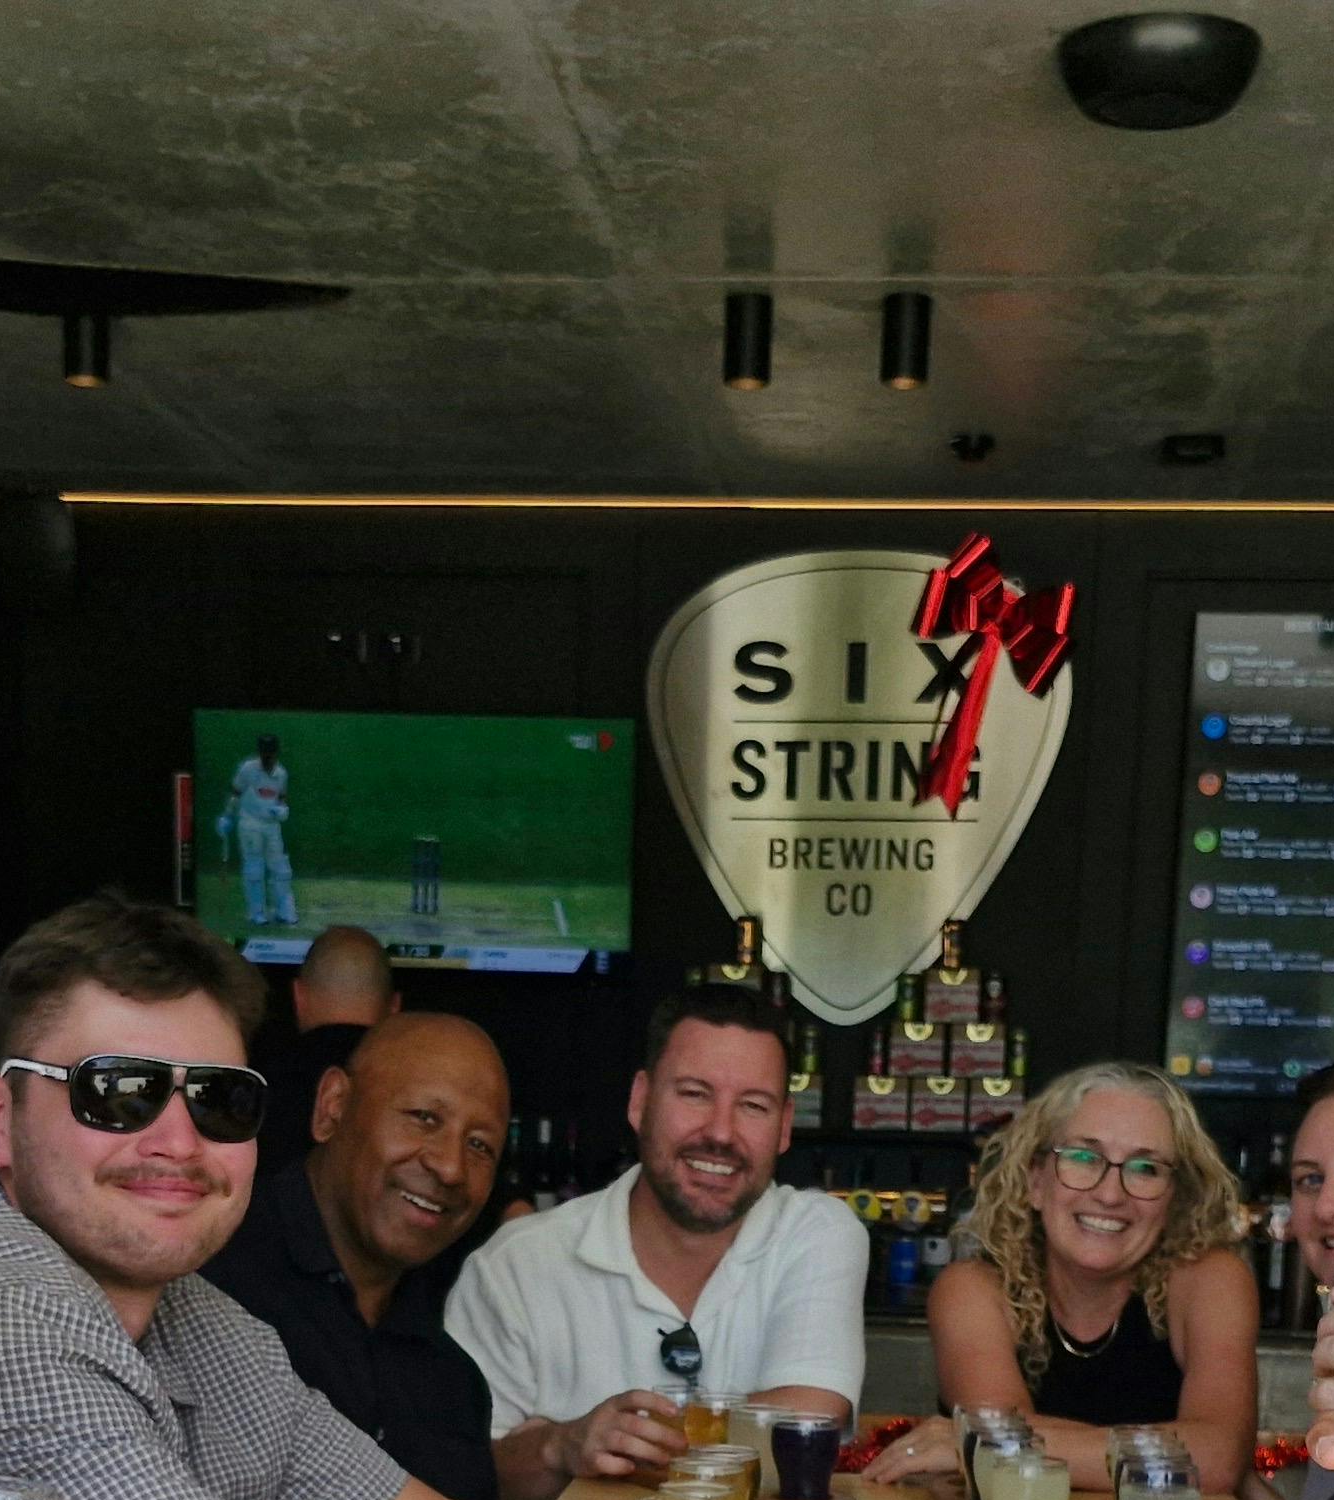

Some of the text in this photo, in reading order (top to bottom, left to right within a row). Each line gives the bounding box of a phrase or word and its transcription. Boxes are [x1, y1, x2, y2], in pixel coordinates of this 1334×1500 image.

[734, 640, 983, 704] SIX
[768, 838, 935, 870] BREWING
[825, 883, 873, 917] CO
